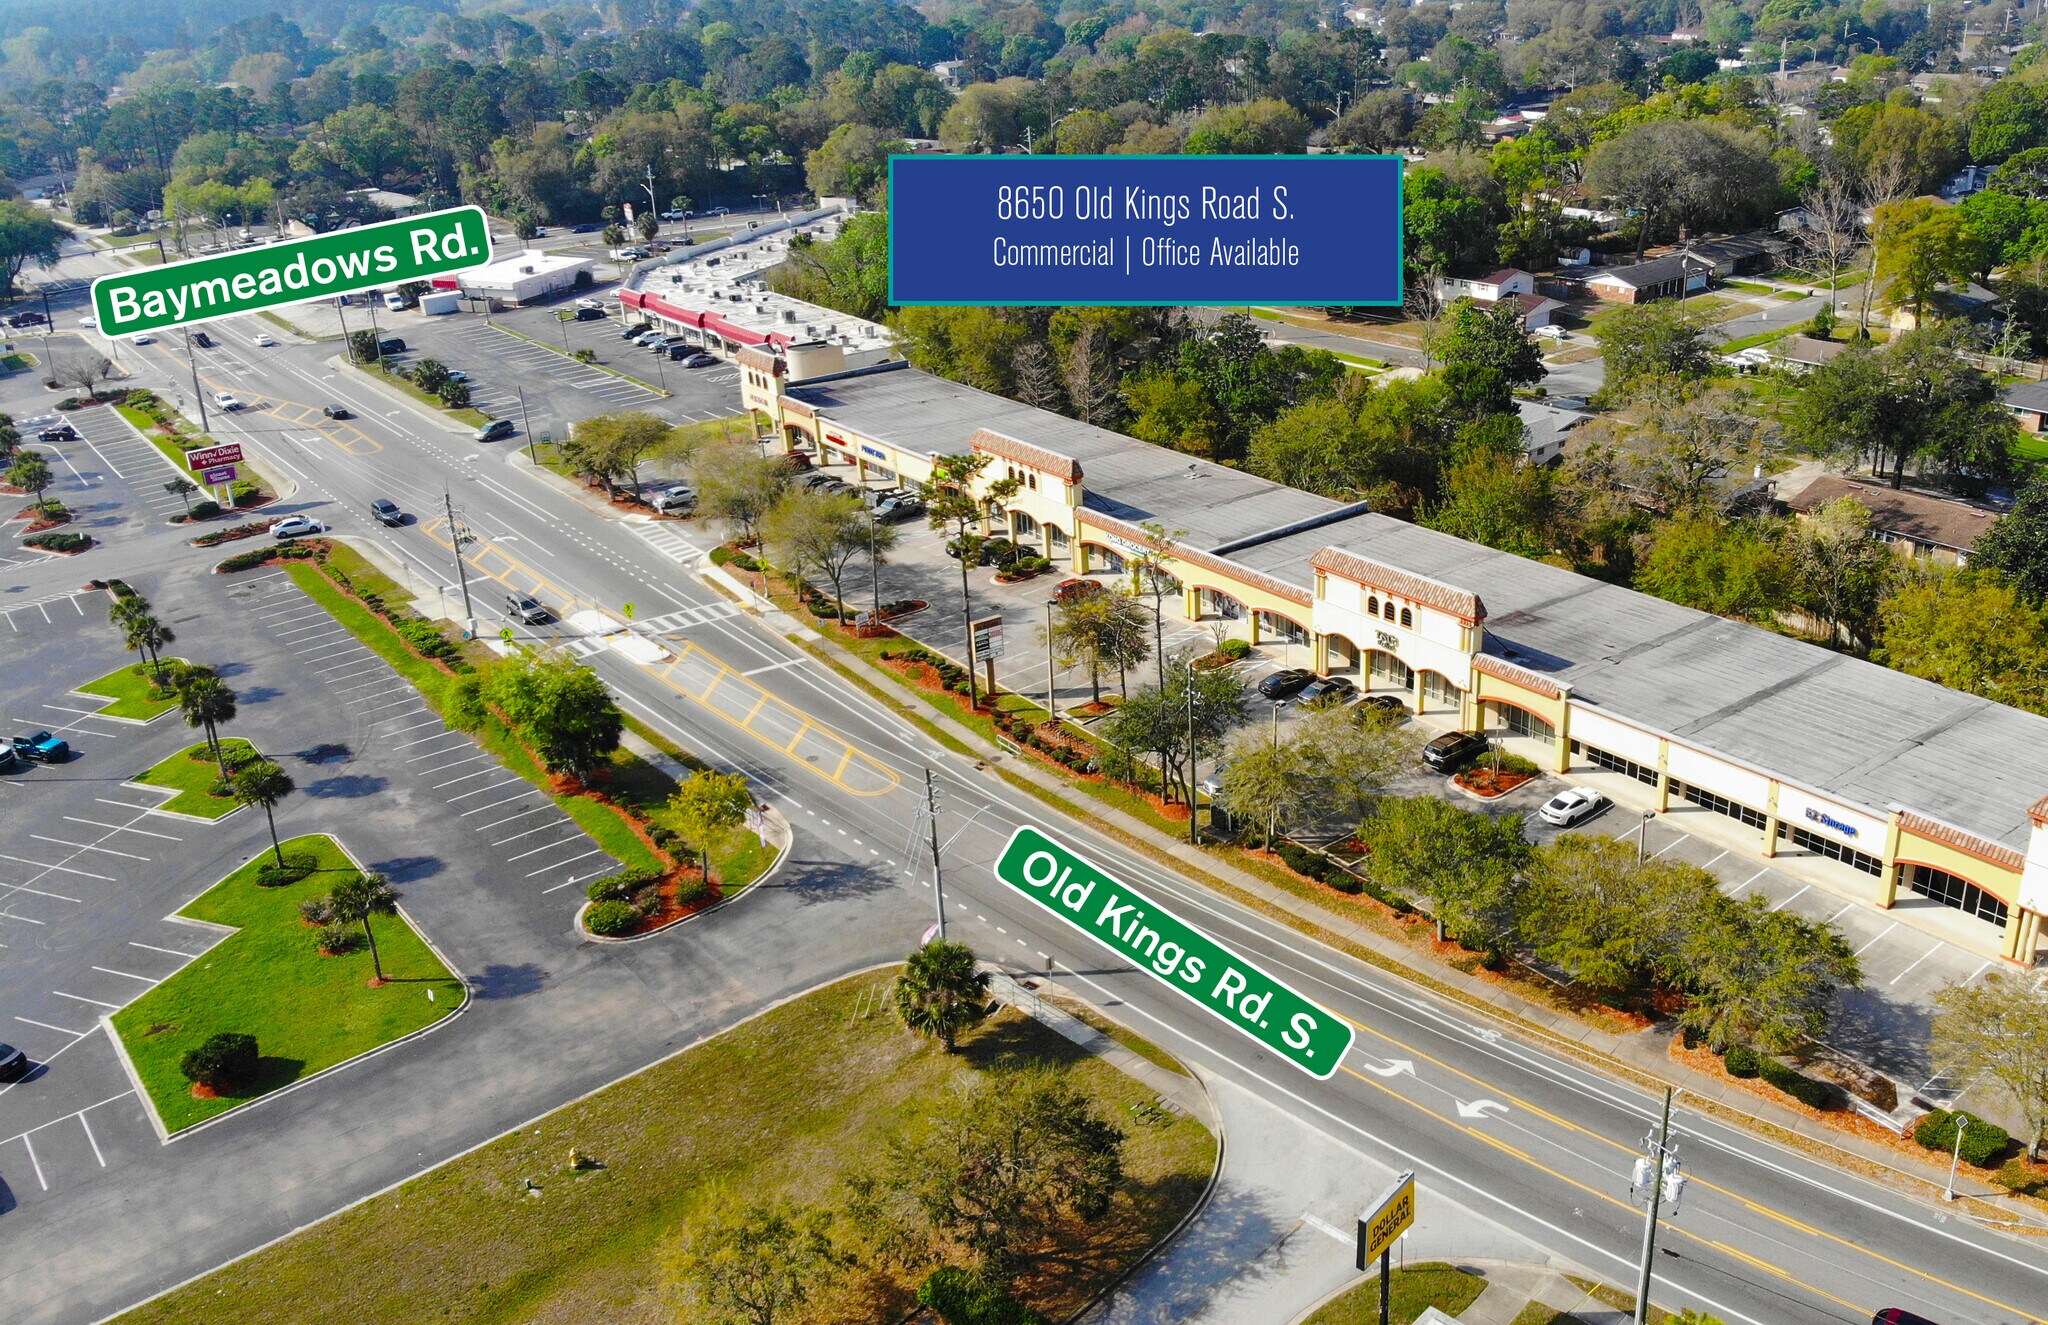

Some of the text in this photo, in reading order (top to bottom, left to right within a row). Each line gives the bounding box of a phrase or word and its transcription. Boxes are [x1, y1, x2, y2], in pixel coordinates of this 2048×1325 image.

[208, 453, 240, 464] Pharmacy
[1820, 813, 1857, 836] Storage
[1370, 1205, 1411, 1252] GENERAL
[1373, 1195, 1409, 1238] DOLLAR
